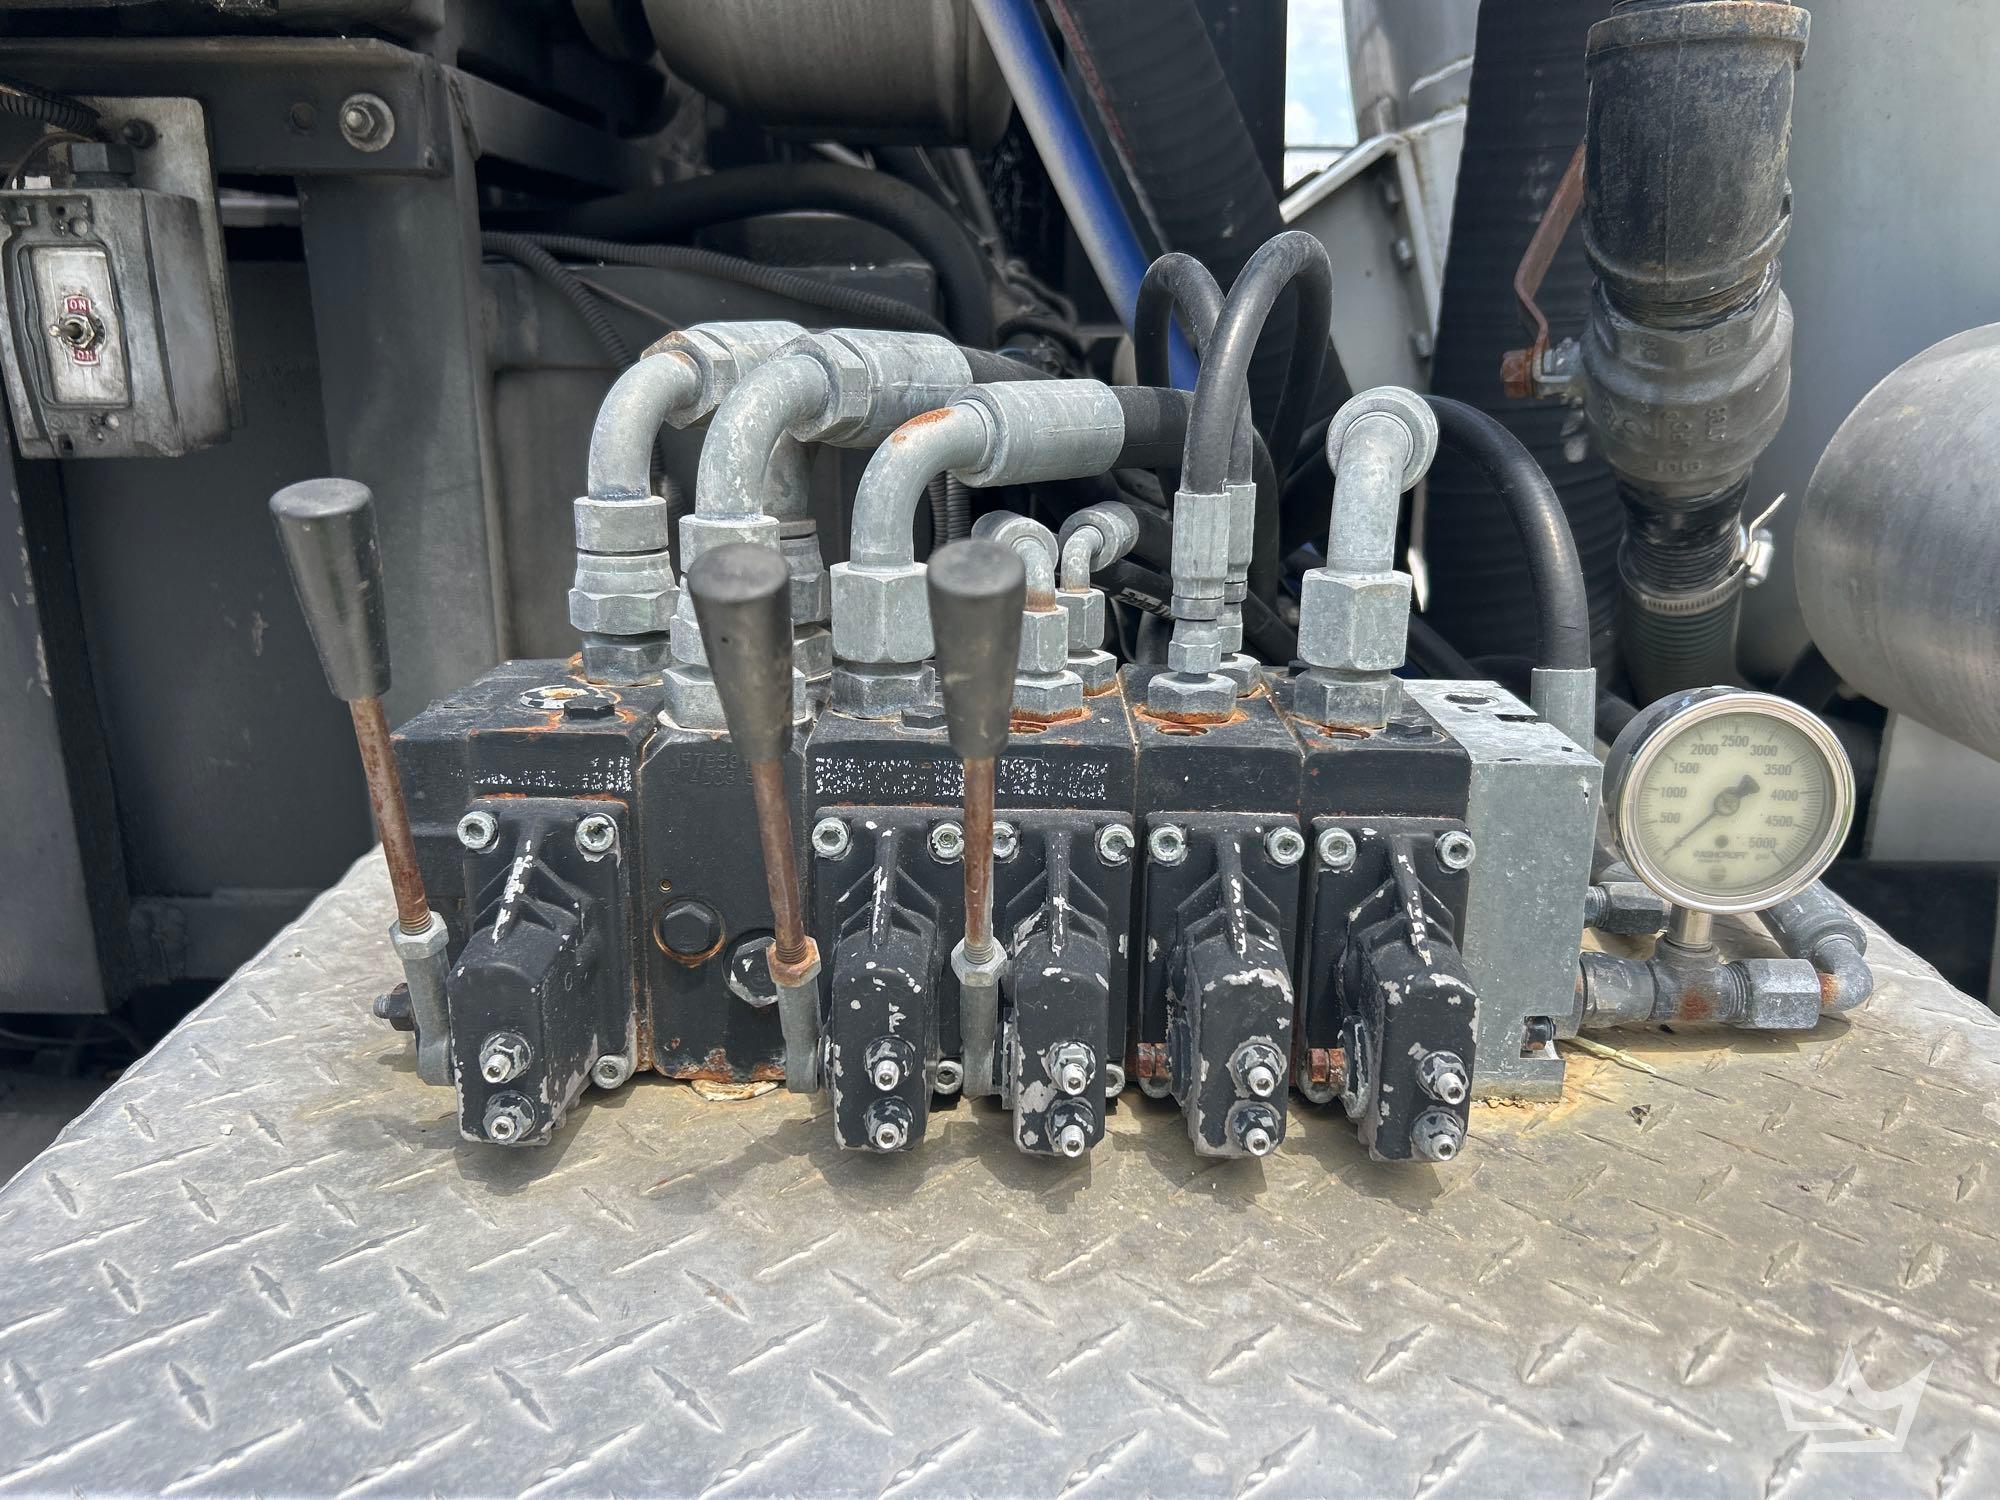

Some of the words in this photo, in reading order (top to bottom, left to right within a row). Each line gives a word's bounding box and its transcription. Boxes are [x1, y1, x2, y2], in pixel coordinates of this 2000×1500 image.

[69, 300, 87, 311] ON
[77, 350, 93, 360] ON
[1722, 735, 1750, 747] 2500
[1691, 744, 1719, 756] 2000
[1750, 745, 1778, 757] 3000
[1674, 763, 1700, 774] 1500
[1764, 764, 1792, 776] 3500
[1662, 787, 1687, 799] 1000
[1771, 789, 1799, 801] 4000
[1661, 812, 1681, 824] 500
[1766, 816, 1794, 828] 4500
[1749, 838, 1777, 849] 5000
